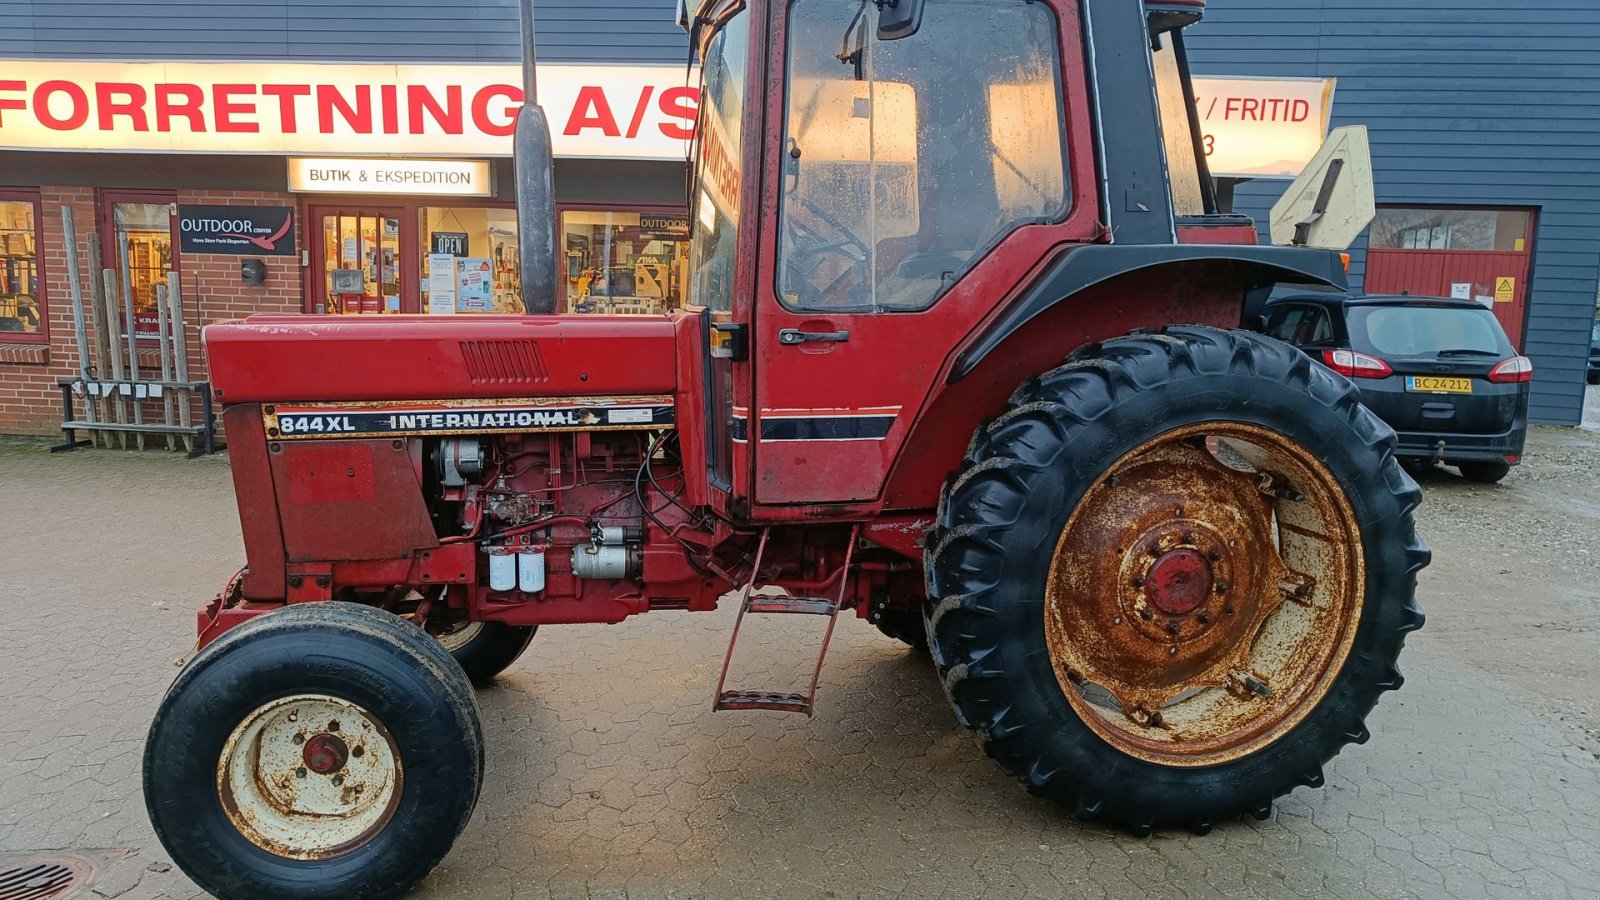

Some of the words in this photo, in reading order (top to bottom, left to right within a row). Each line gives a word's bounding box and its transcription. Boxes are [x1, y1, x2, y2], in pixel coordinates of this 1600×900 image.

[0, 79, 525, 136] FORRETNING
[563, 85, 700, 140] A/S
[1224, 97, 1310, 122] FRITID
[310, 169, 351, 182] BUTIK
[359, 170, 368, 182] &
[375, 170, 471, 184] EKSPEDITION
[181, 218, 252, 233] OUTDOOR
[641, 218, 687, 229] OUTDOOR
[438, 238, 462, 254] OPEN
[1415, 378, 1430, 388] BC
[1433, 379, 1447, 389] 24
[1449, 379, 1470, 390] 212
[389, 411, 579, 429] INTERNATIONAL
